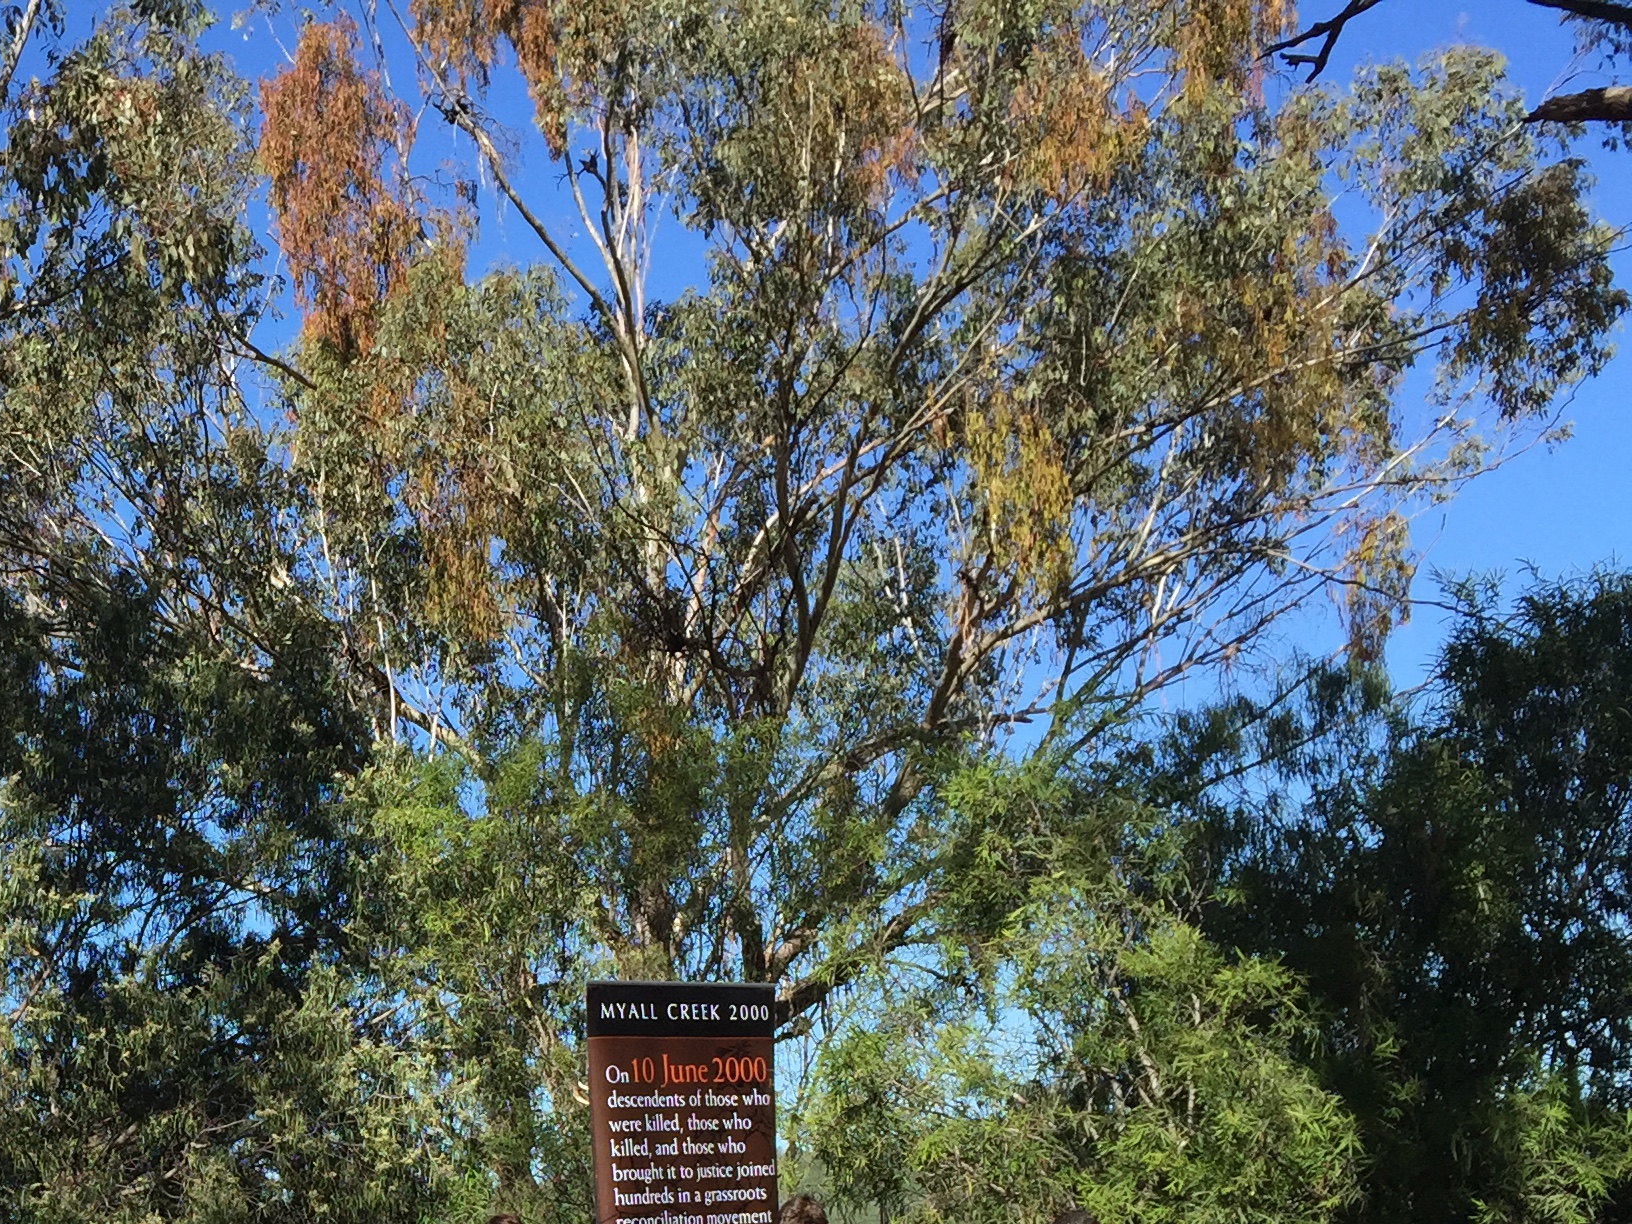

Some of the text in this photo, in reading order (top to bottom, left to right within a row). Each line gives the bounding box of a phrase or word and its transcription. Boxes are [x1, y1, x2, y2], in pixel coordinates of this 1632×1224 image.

[601, 1003, 768, 1021] MYALL CREEK 2000
[606, 1065, 629, 1084] On
[631, 1057, 654, 1083] 10
[661, 1053, 708, 1088] June
[608, 1088, 770, 1108] descendents of those who
[609, 1112, 751, 1133] were killed, those who
[610, 1136, 745, 1157] killed, and those who
[612, 1159, 775, 1184] brought it to justice joined
[614, 1186, 767, 1206] hundreds in a grassroots
